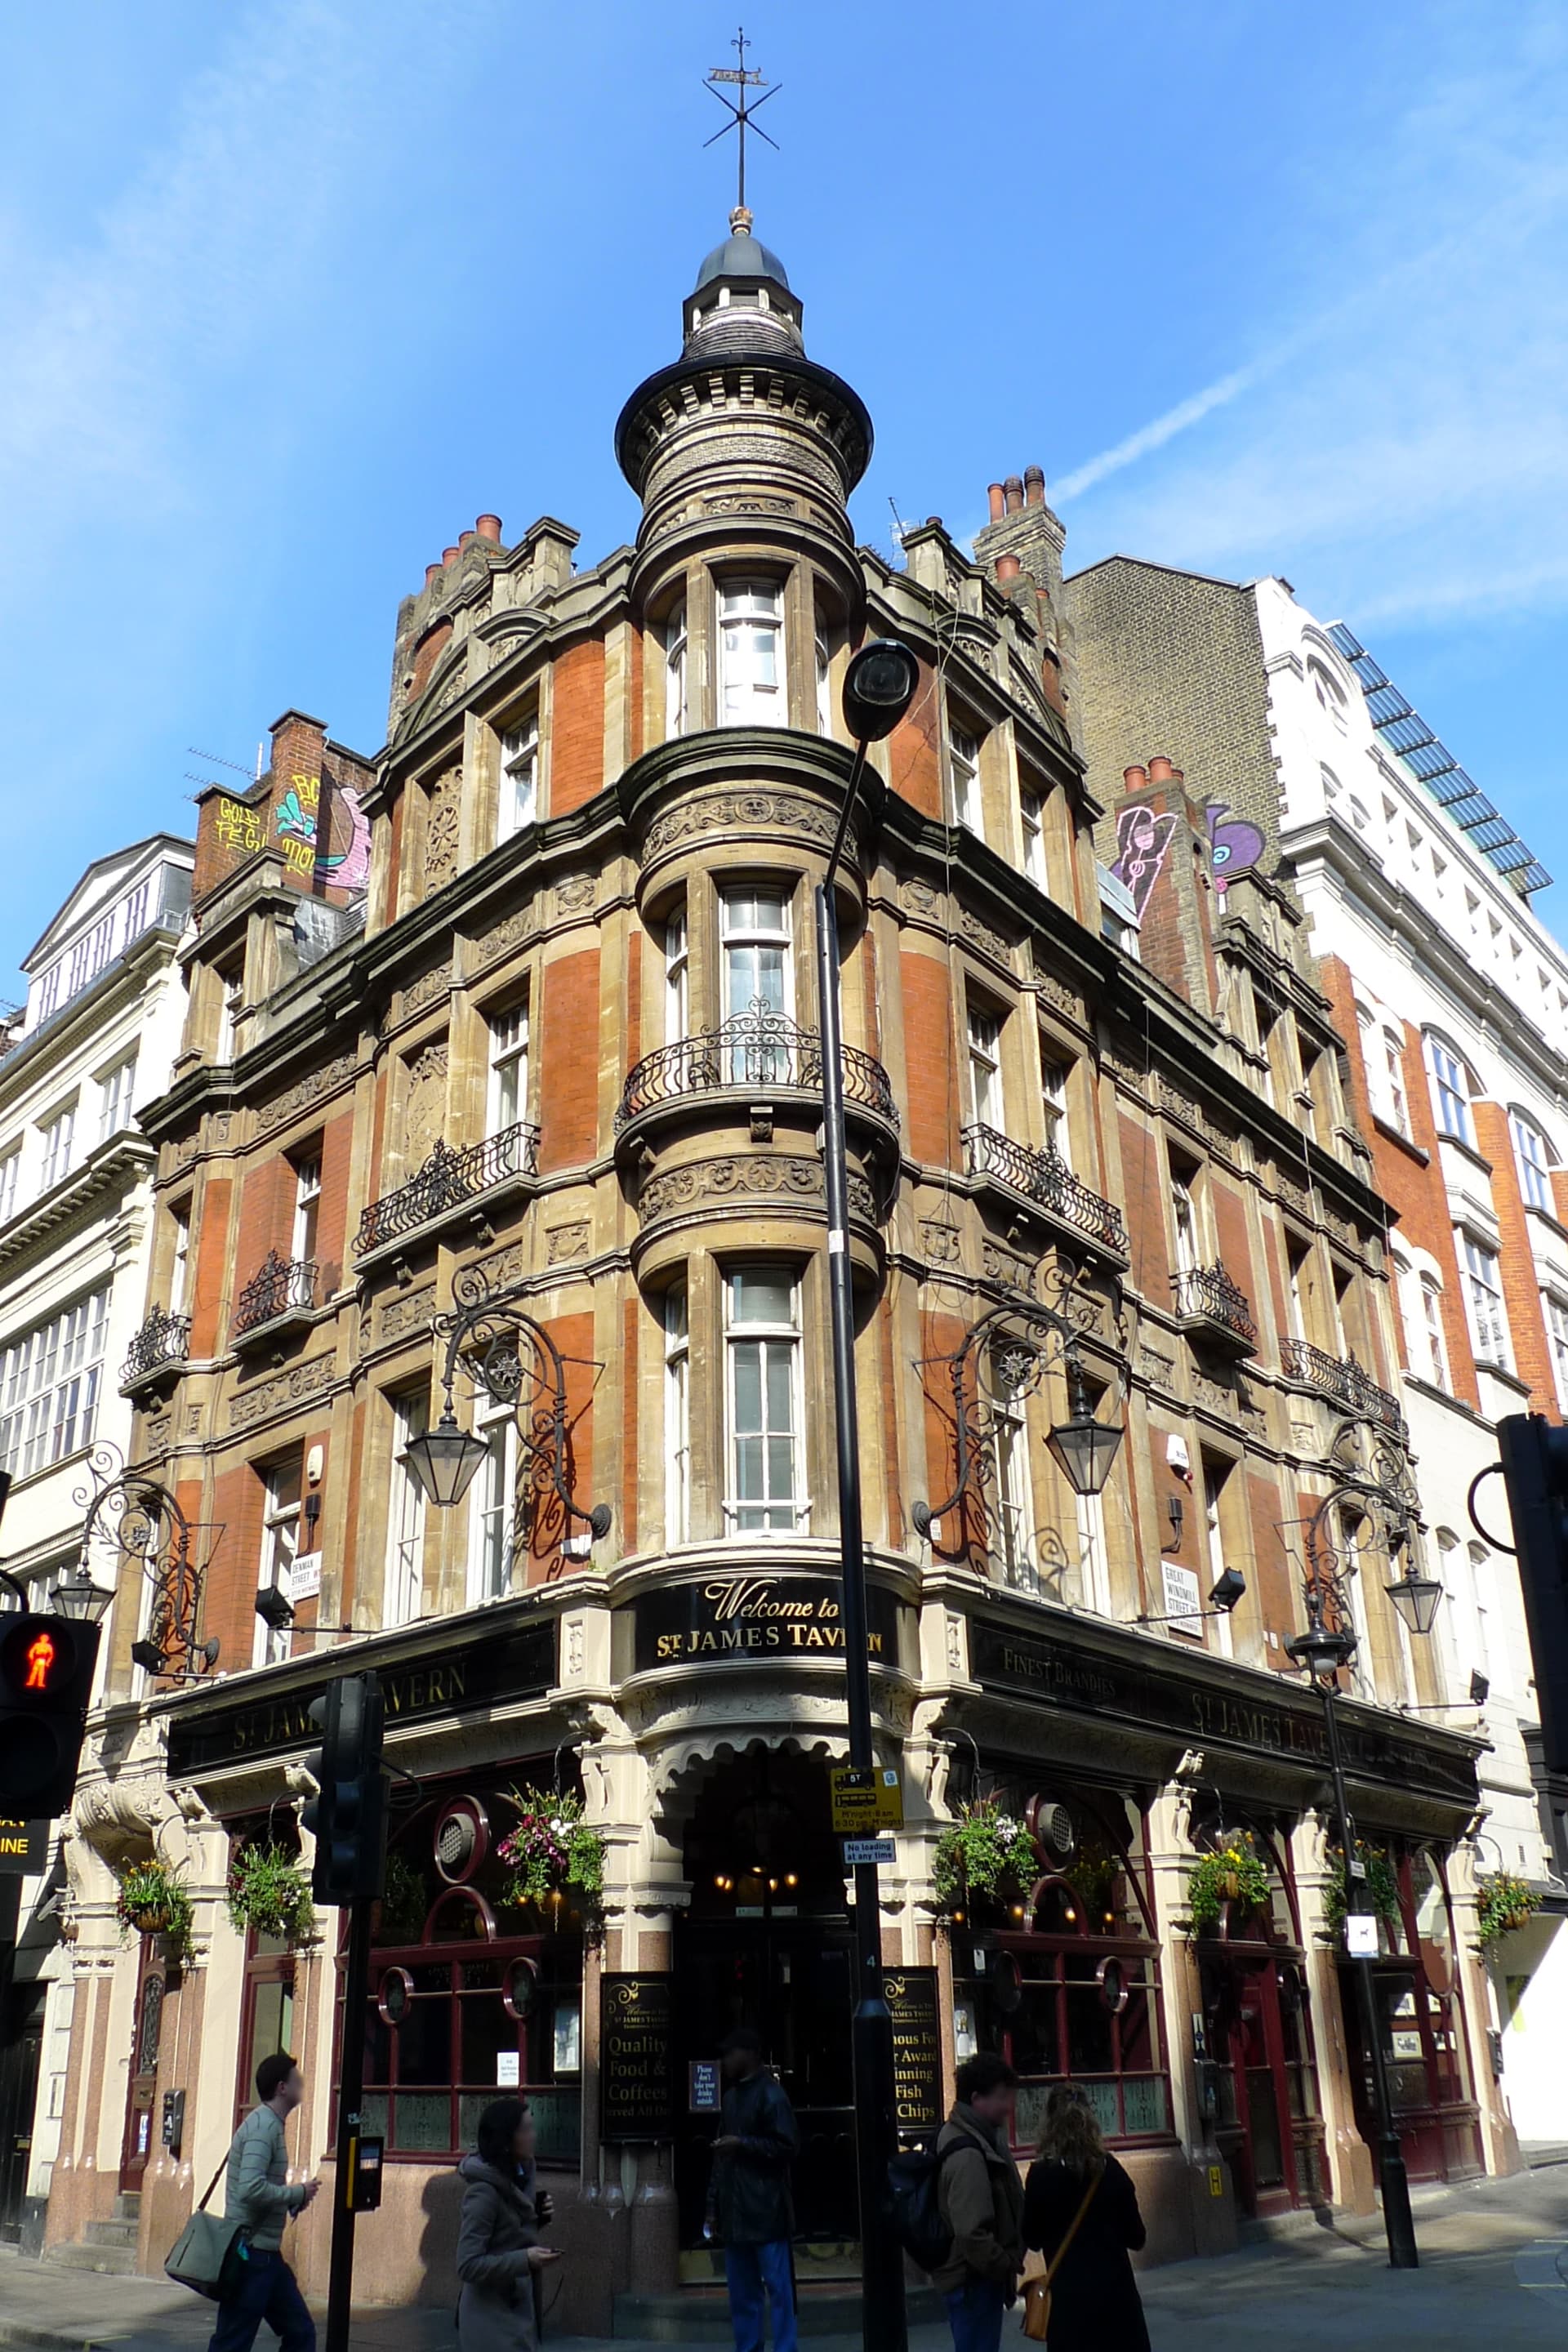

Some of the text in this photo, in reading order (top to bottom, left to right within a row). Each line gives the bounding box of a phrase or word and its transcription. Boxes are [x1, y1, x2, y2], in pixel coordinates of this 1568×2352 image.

[220, 797, 261, 828] GOLD
[292, 1571, 310, 1586] STREET
[1165, 1566, 1183, 1584] GREAT
[704, 1579, 840, 1621] Welcome to
[1166, 1582, 1196, 1604] WINDMILL
[1168, 1597, 1190, 1615] STREET
[687, 1626, 780, 1653] JAMES
[786, 1624, 882, 1652] TAVN
[379, 1661, 467, 1714] AVERN
[263, 1705, 324, 1744] JAM
[1220, 1699, 1281, 1746] JAMES
[1285, 1717, 1354, 1765] TAVEN
[847, 1842, 891, 1852] No loading
[847, 1851, 892, 1862] at any time
[866, 1955, 876, 1968] 4
[608, 2036, 667, 2057] Quality
[901, 2048, 937, 2063] Award
[610, 2059, 667, 2078] Food &
[894, 2066, 933, 2083] inning
[608, 2083, 667, 2102] Coffees
[895, 2084, 923, 2098] Fish
[897, 2103, 935, 2122] Chips
